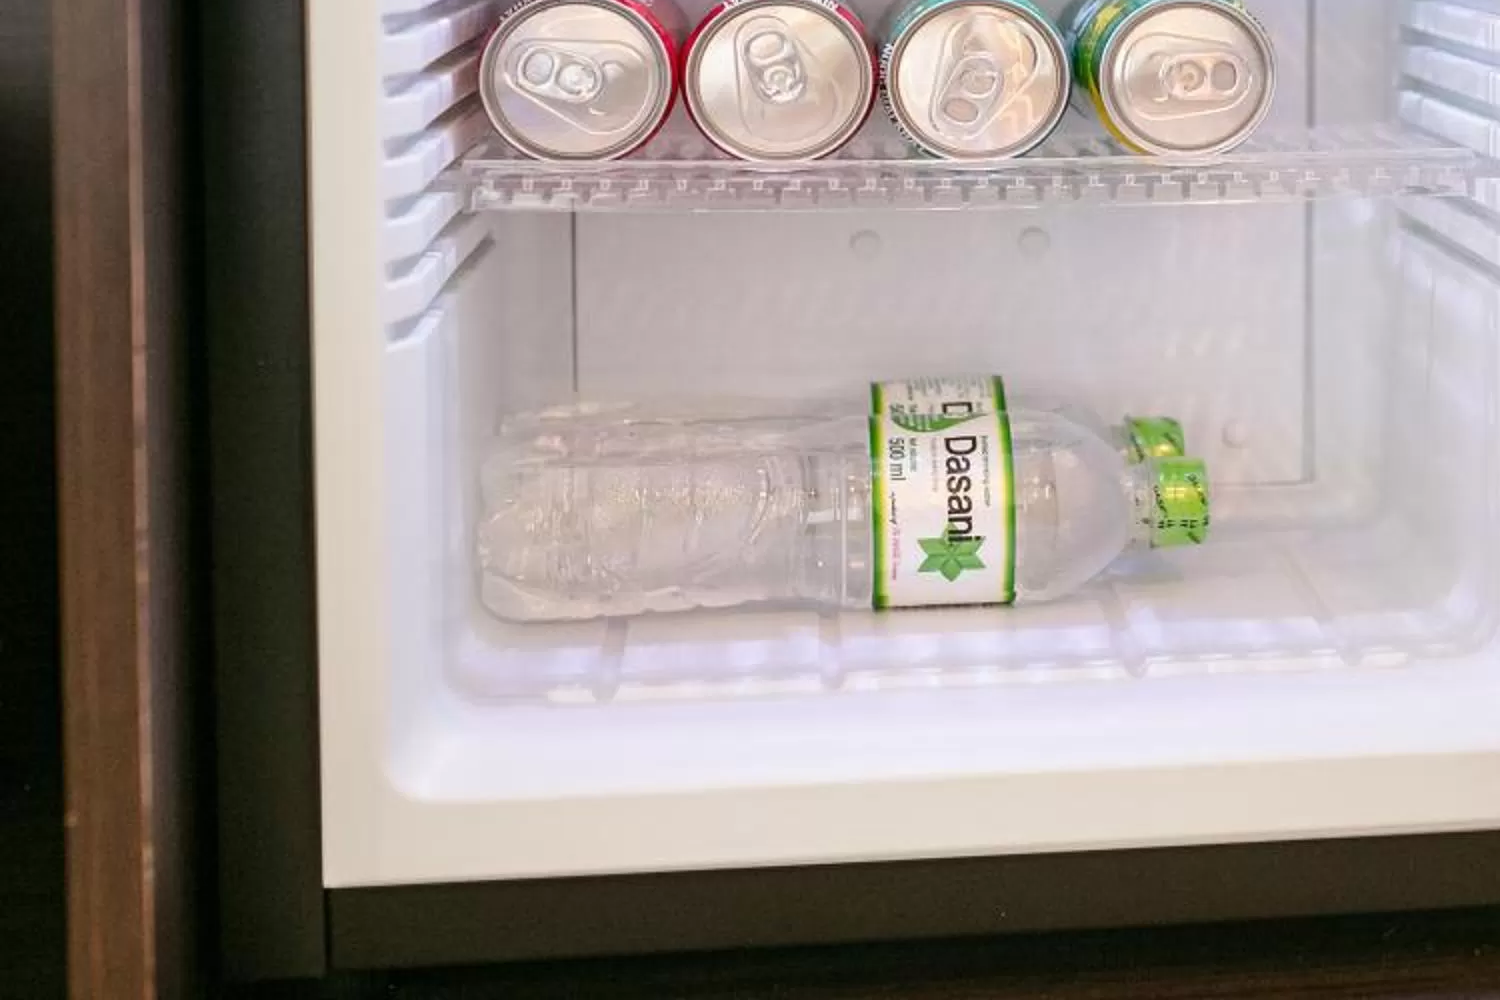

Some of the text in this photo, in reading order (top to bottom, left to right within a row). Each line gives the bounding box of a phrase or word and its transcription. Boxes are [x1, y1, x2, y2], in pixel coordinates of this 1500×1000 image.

[888, 437, 905, 460] 500
[890, 463, 907, 482] ml
[944, 435, 982, 543] Dasani
